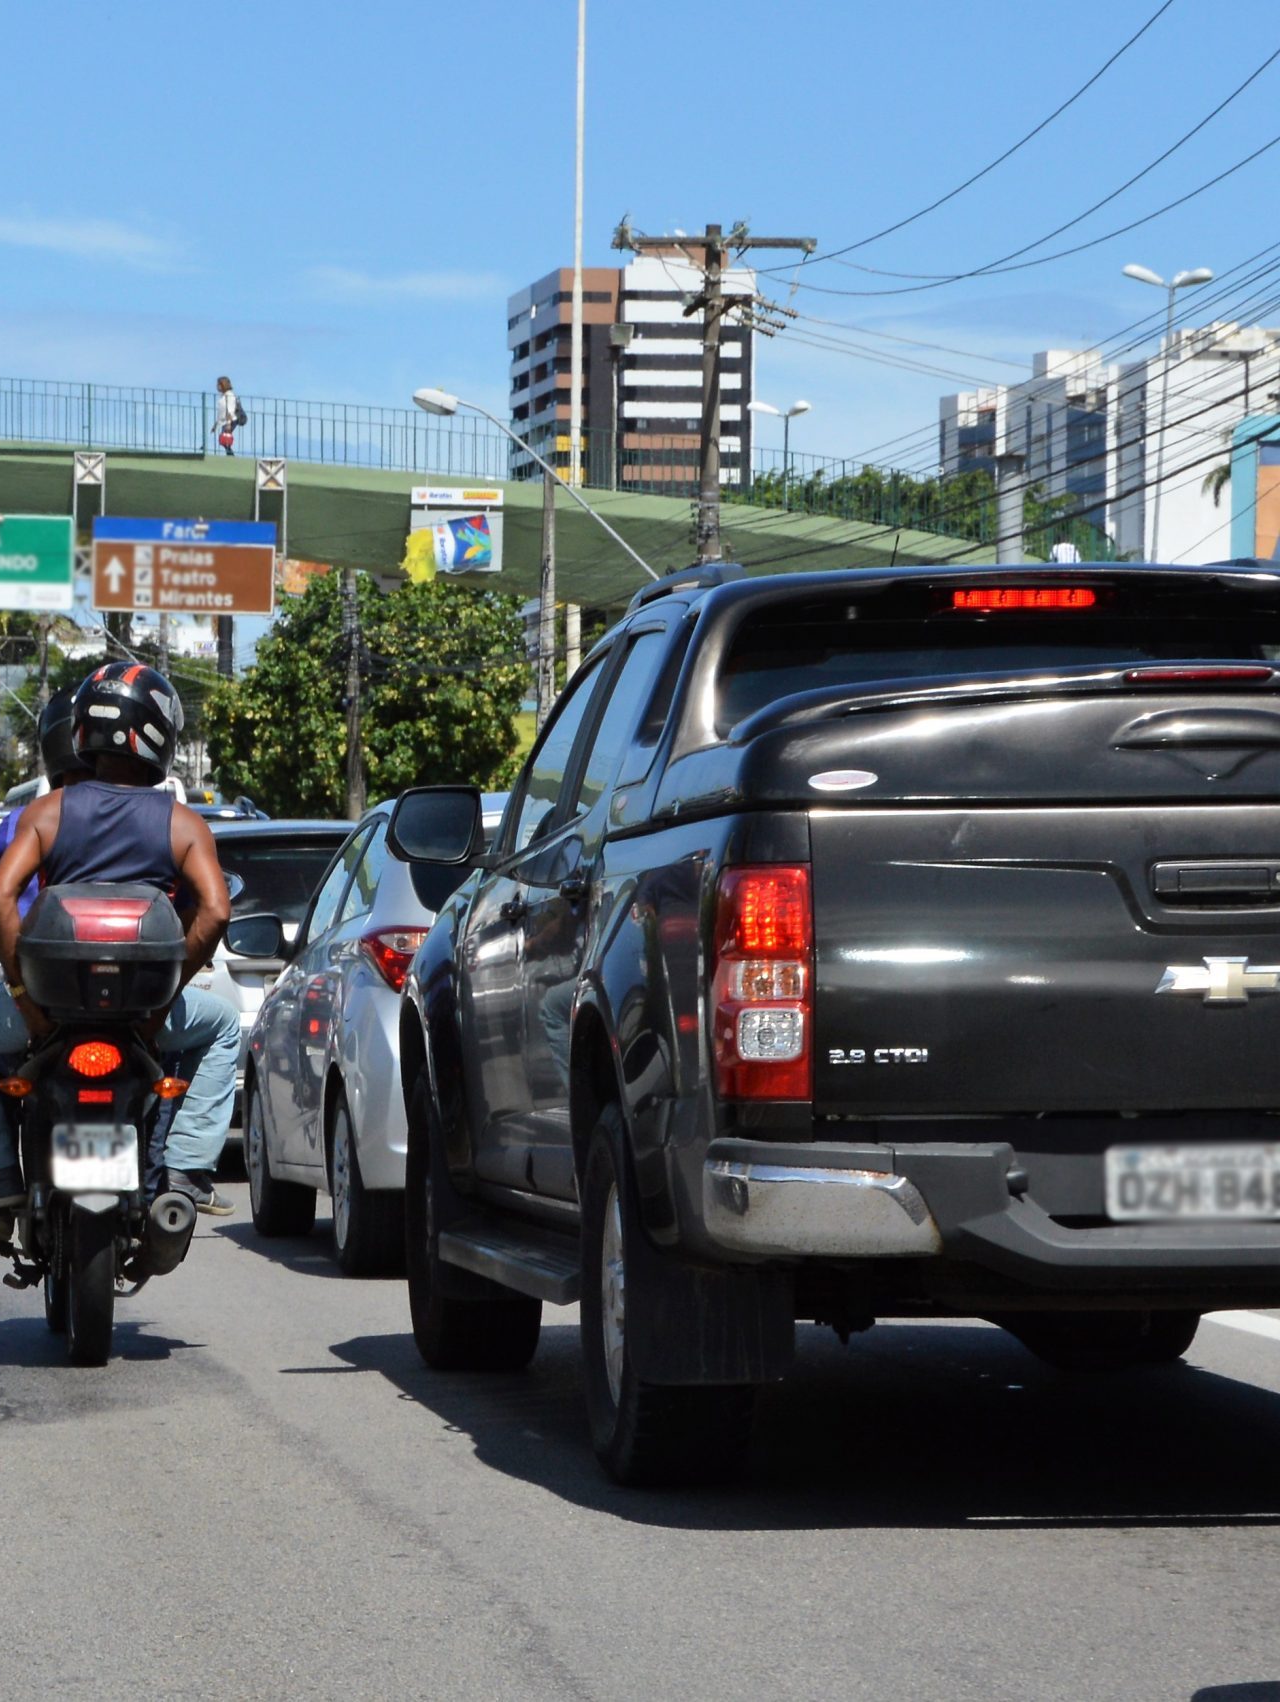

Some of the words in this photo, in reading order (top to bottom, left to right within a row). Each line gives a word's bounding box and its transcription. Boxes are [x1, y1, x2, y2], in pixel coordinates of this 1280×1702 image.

[160, 549, 215, 566] Praias
[161, 569, 217, 586] Teatro
[160, 590, 233, 607] Mirantes
[873, 1048, 928, 1063] CTDI
